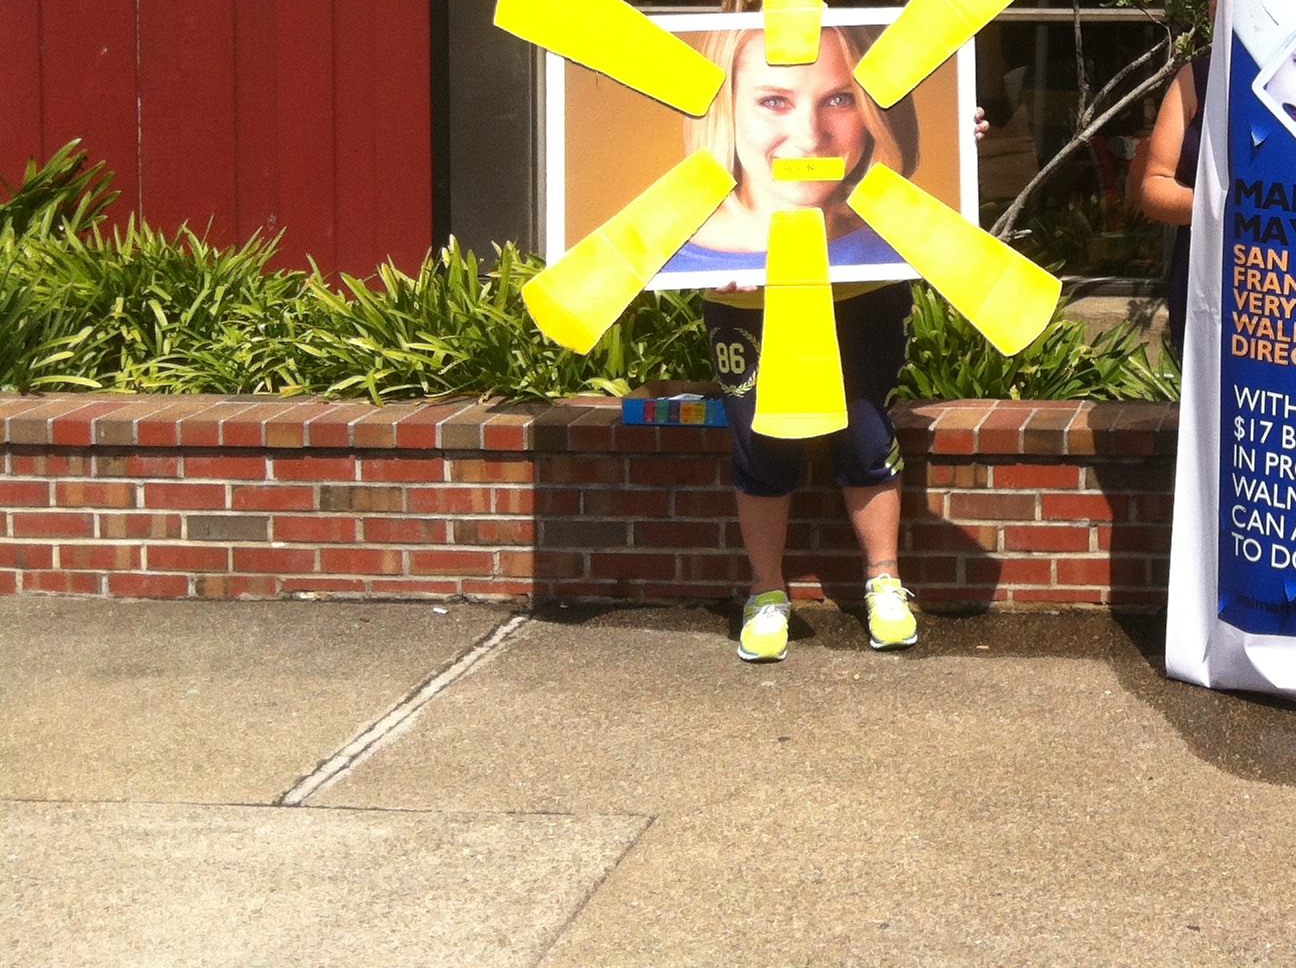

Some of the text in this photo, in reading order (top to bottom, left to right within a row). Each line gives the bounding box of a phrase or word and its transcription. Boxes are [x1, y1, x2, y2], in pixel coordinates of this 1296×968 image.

[1233, 244, 1290, 272] SAN
[716, 342, 746, 374] 86
[1233, 415, 1274, 444] $17
[1233, 444, 1256, 472] IN
[1231, 504, 1286, 539] CAN
[1231, 532, 1263, 562] TO
